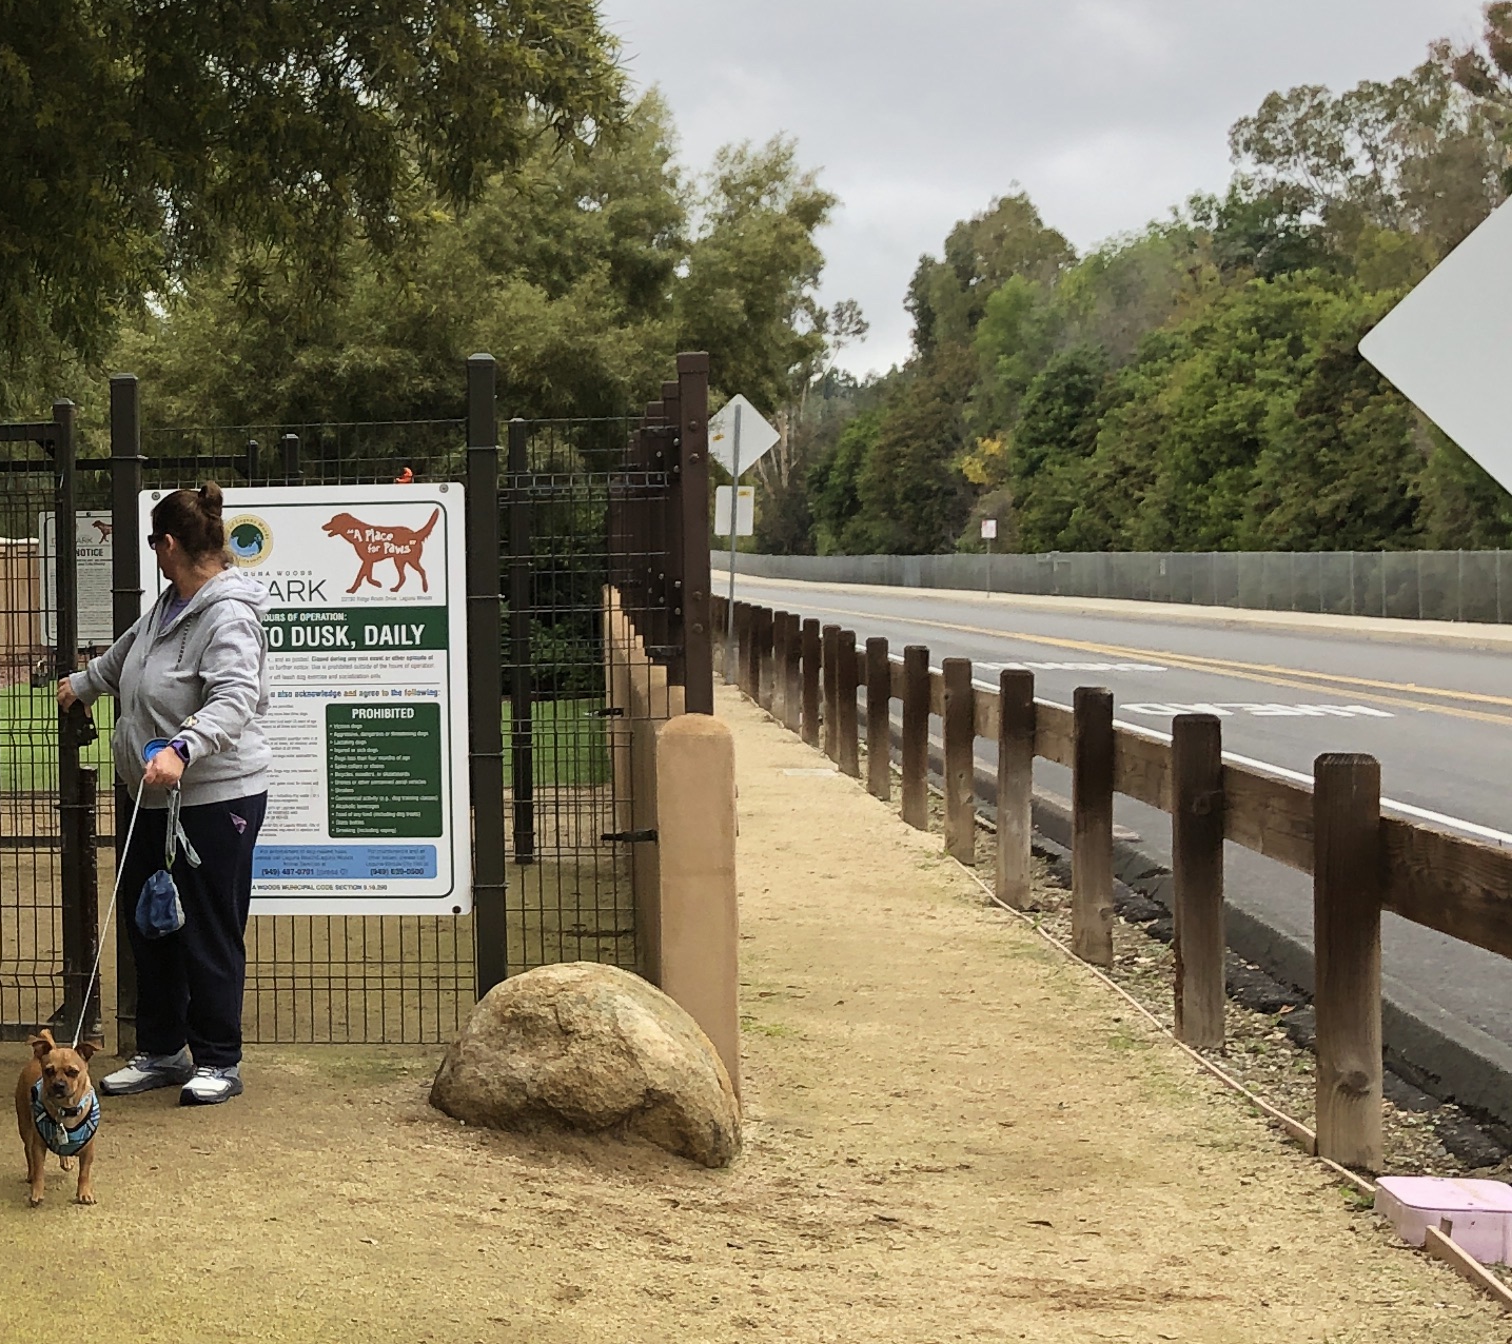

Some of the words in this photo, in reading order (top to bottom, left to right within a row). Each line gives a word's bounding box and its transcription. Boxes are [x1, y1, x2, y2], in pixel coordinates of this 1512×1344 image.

[365, 528, 394, 543] Place
[368, 543, 381, 553] for
[267, 579, 327, 602] ARK
[287, 613, 299, 621] OF
[300, 613, 347, 621] OPERATION:
[291, 625, 356, 649] DUSK,
[364, 624, 425, 646] DAILY
[295, 689, 341, 699] acknowledge
[344, 689, 357, 697] and
[359, 690, 379, 698] agree
[391, 688, 402, 696] the
[351, 707, 415, 719] PROHIBITED
[261, 868, 280, 876] (949)
